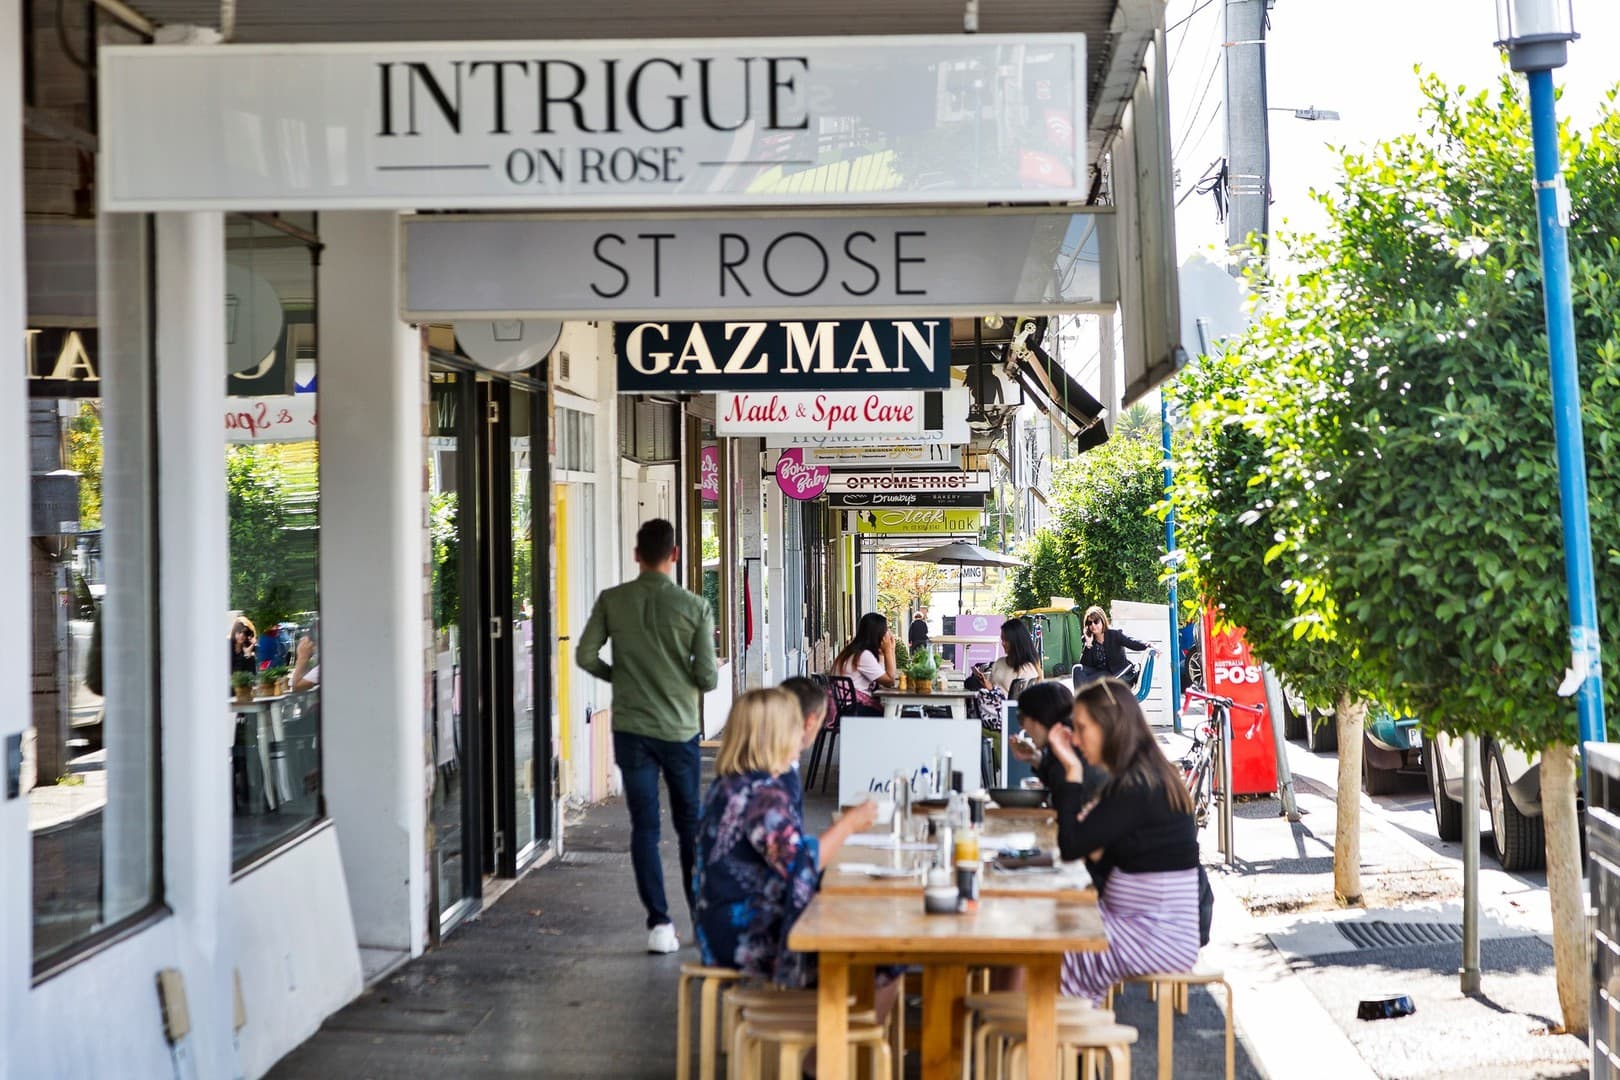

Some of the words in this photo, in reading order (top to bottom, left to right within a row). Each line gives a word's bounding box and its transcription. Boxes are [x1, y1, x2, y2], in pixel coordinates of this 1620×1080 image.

[375, 56, 810, 137] INTRIGUE
[505, 146, 566, 185] ON
[578, 146, 684, 184] ROSE
[590, 232, 676, 298] ST
[719, 230, 927, 297] ROSE
[724, 394, 790, 422] Nails
[795, 402, 807, 418] &
[812, 394, 858, 431] Spa
[863, 394, 914, 422] Care
[791, 469, 829, 494] Baby
[846, 476, 970, 489] OPTOMETRIST
[944, 517, 975, 530] look
[1214, 665, 1262, 685] POS
